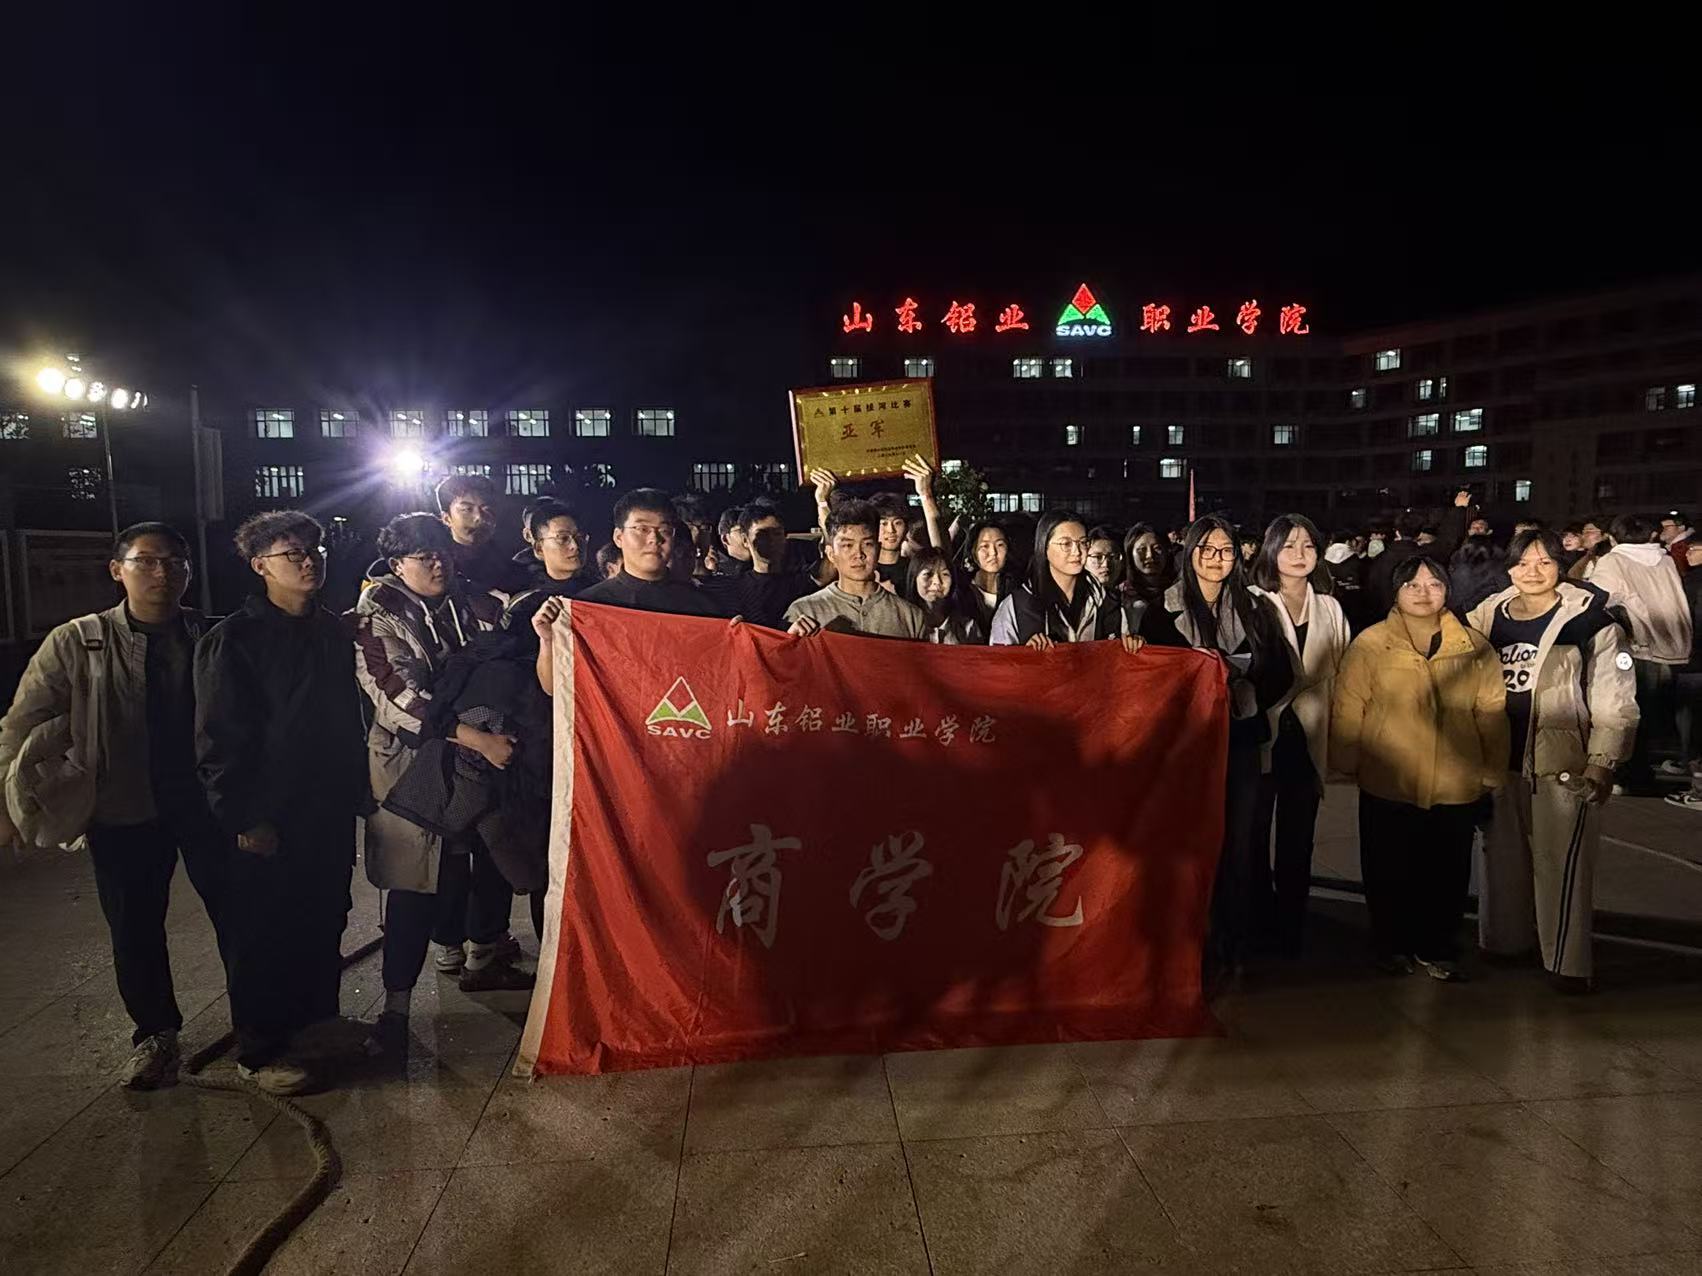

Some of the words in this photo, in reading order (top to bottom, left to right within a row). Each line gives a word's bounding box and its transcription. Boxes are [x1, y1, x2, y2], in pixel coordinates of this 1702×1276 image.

[843, 297, 1029, 333] 山东铝业
[1140, 299, 1310, 334] 职业学院
[1055, 325, 1113, 336] SAVC
[841, 419, 885, 440] 亚军
[647, 725, 711, 739] SAVC
[726, 699, 996, 746] 山东铝业职业学院
[706, 823, 1084, 949] 商学院
